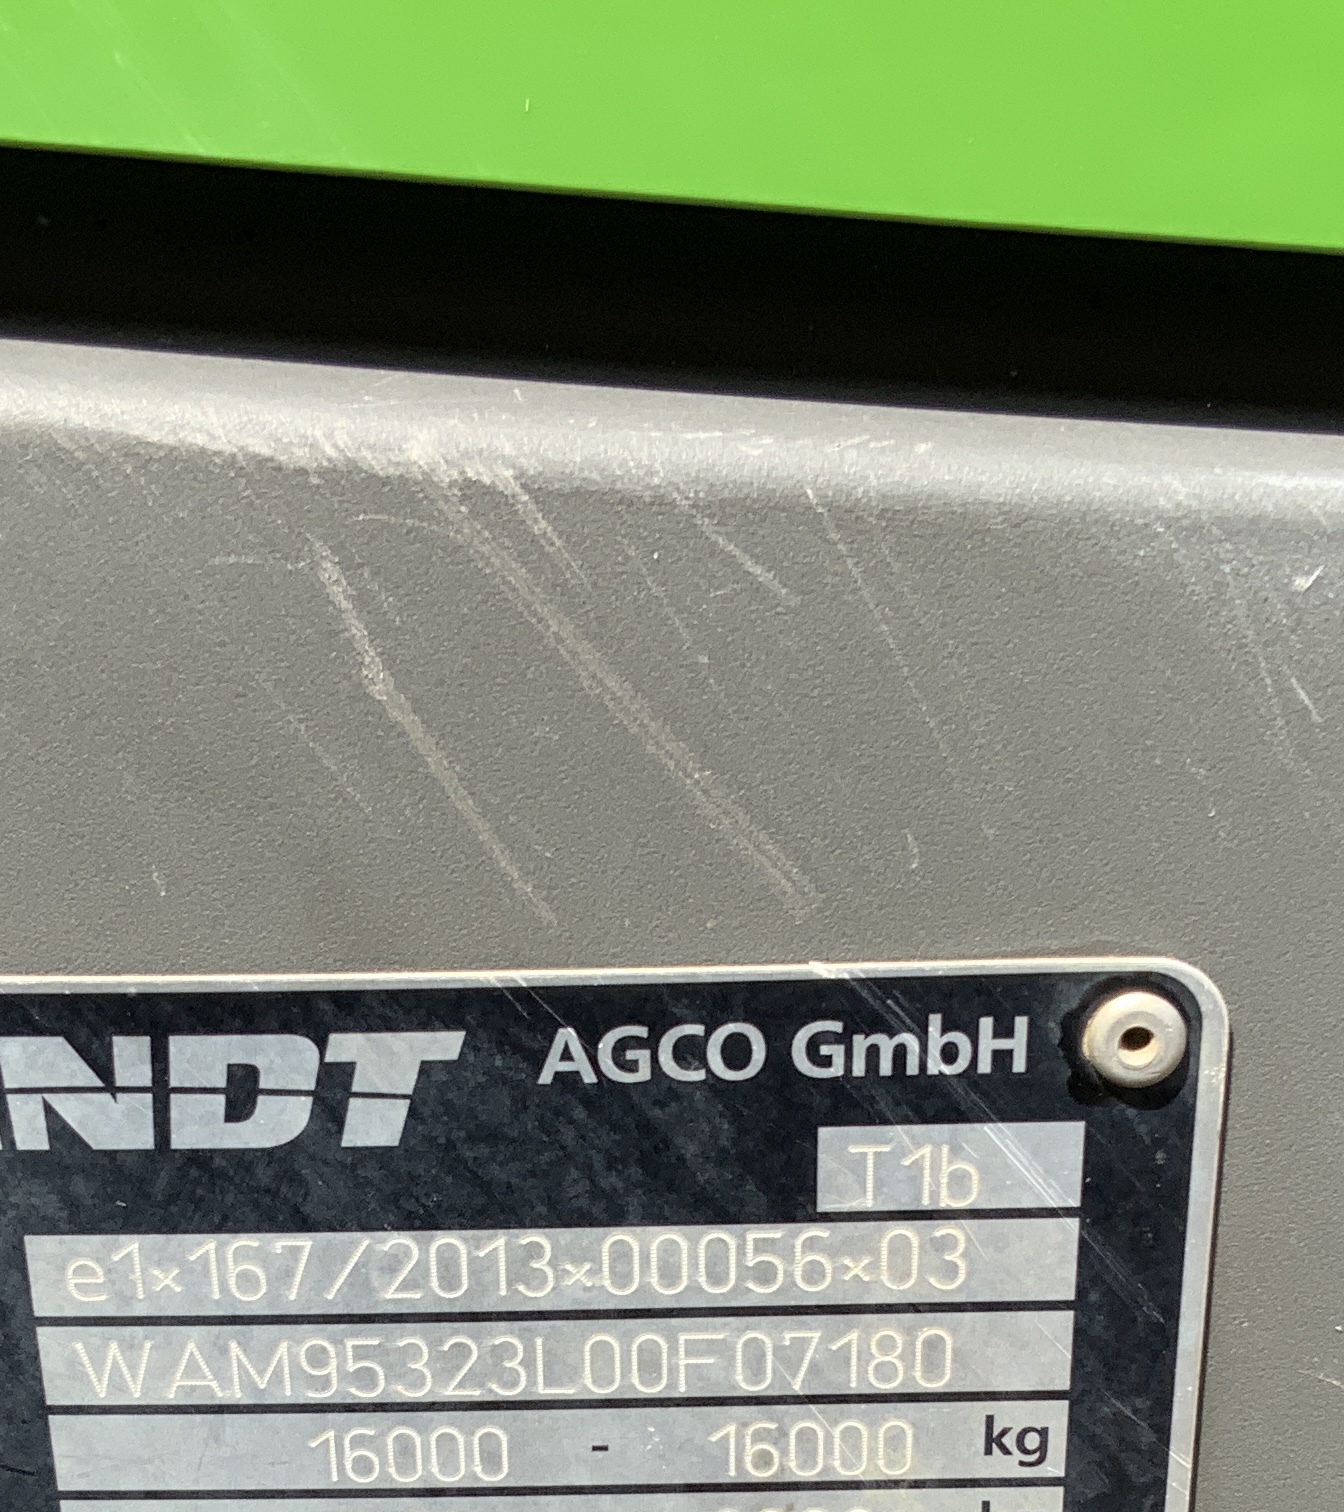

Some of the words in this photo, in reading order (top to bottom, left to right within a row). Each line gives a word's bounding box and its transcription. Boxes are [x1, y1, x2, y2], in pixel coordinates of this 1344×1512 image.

[538, 1021, 766, 1085] AGCO
[791, 1015, 1029, 1077] GmbH
[307, 1425, 510, 1483] 16000
[707, 1419, 914, 1477] 16000
[982, 1414, 1050, 1468] kg
